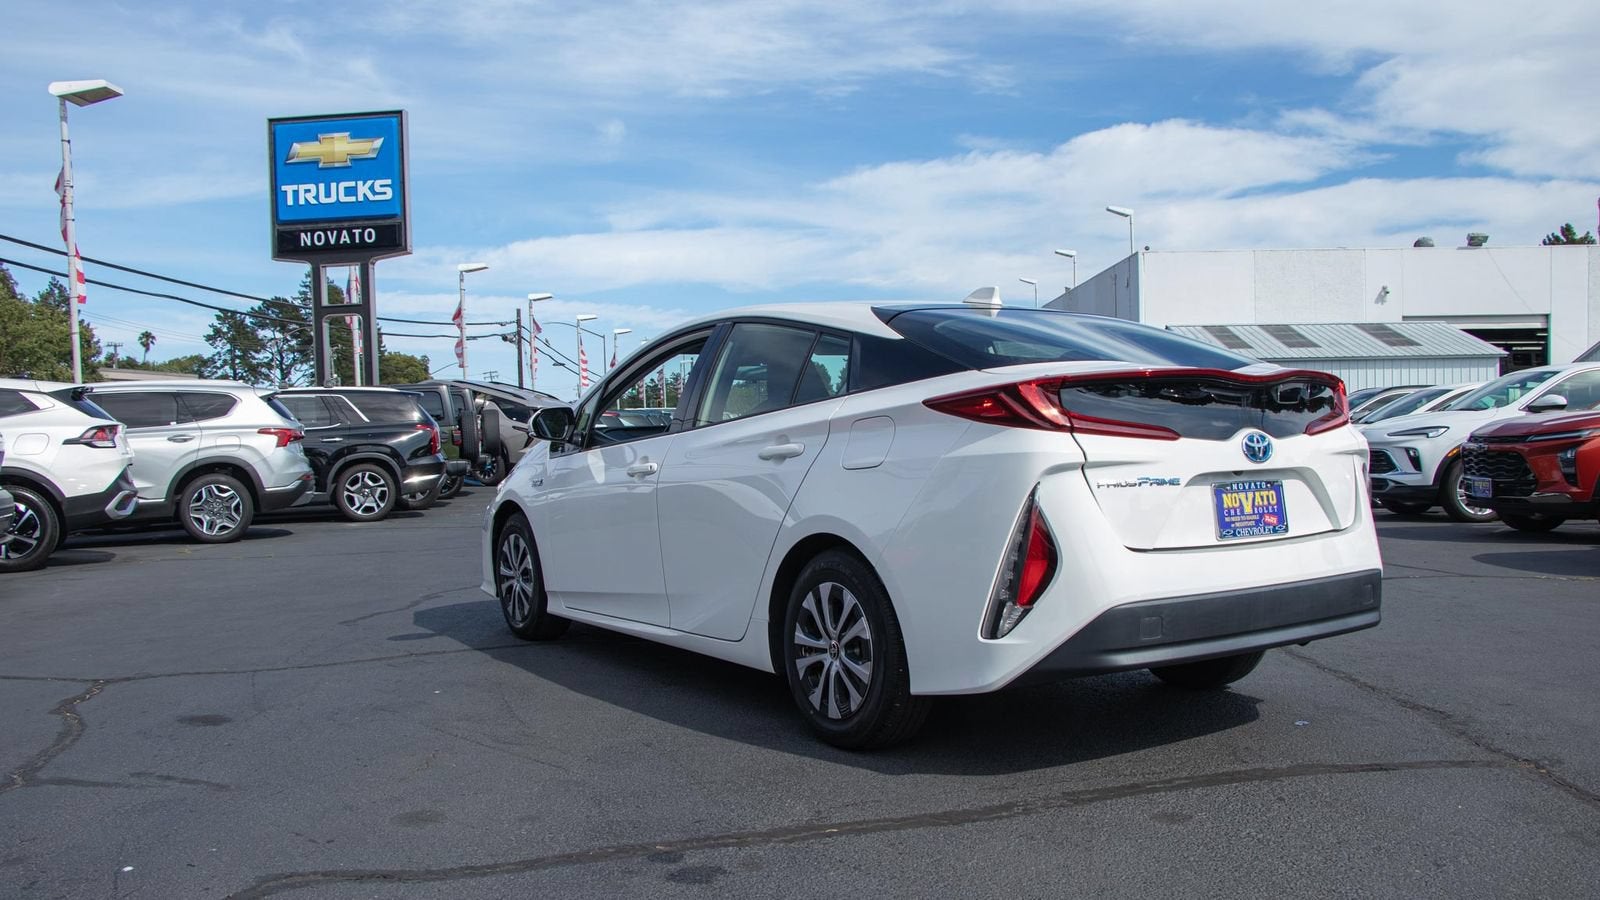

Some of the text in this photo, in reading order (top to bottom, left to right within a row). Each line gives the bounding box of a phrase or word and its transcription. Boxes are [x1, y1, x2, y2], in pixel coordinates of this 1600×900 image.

[281, 178, 393, 206] TRUCKS
[300, 227, 376, 247] NOVATO
[1232, 481, 1266, 490] NOVATO
[1222, 490, 1277, 514] NOVATO
[1235, 526, 1273, 537] CHEVROLET
